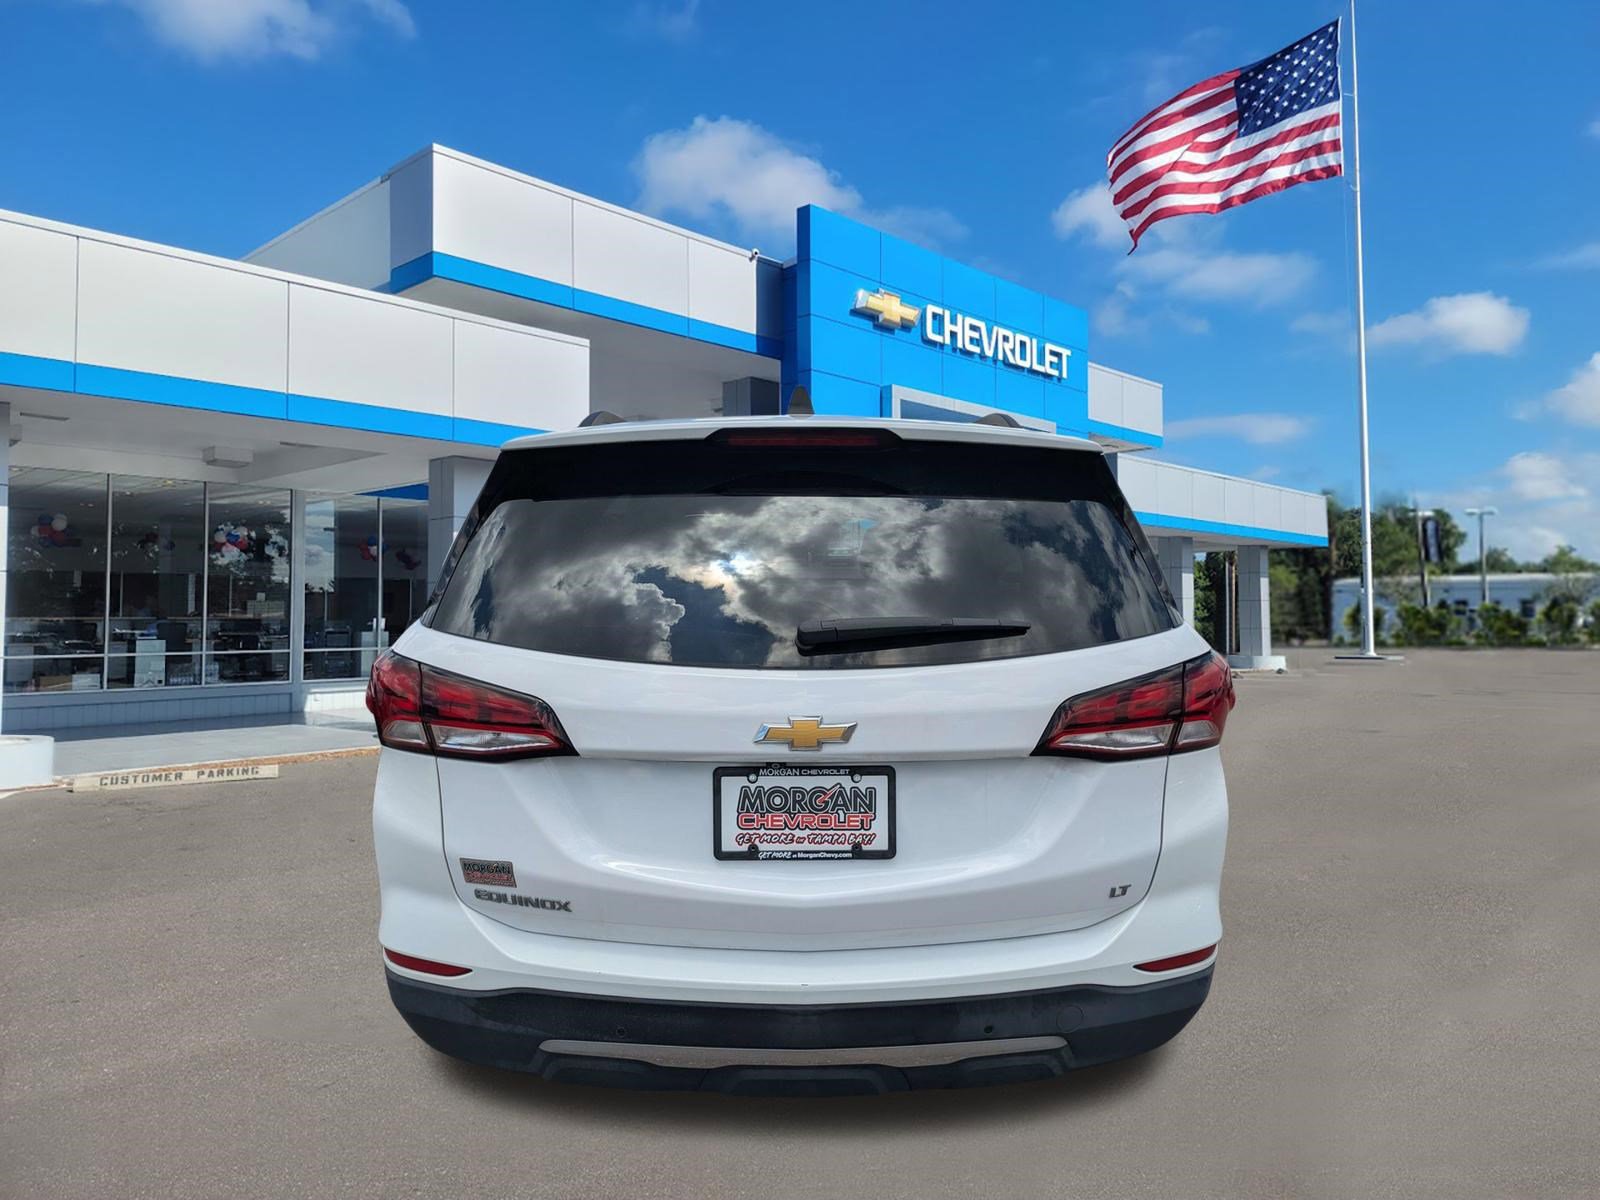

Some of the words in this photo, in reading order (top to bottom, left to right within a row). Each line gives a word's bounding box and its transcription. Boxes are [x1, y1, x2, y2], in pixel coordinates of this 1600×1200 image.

[925, 304, 1072, 379] CHEVROLET
[100, 771, 183, 786] CUSTOMER
[197, 766, 259, 779] PARKING
[759, 768, 800, 776] MORGAN
[738, 784, 876, 813] MORGAN
[738, 813, 875, 830] CHEVROLET
[736, 833, 760, 845] GET
[760, 833, 794, 845] MORE
[807, 833, 846, 845] TAMPA
[848, 833, 876, 845] BAY!
[463, 863, 512, 875] MORGAN
[1109, 884, 1132, 898] LT
[474, 888, 572, 912] EQUINOX
